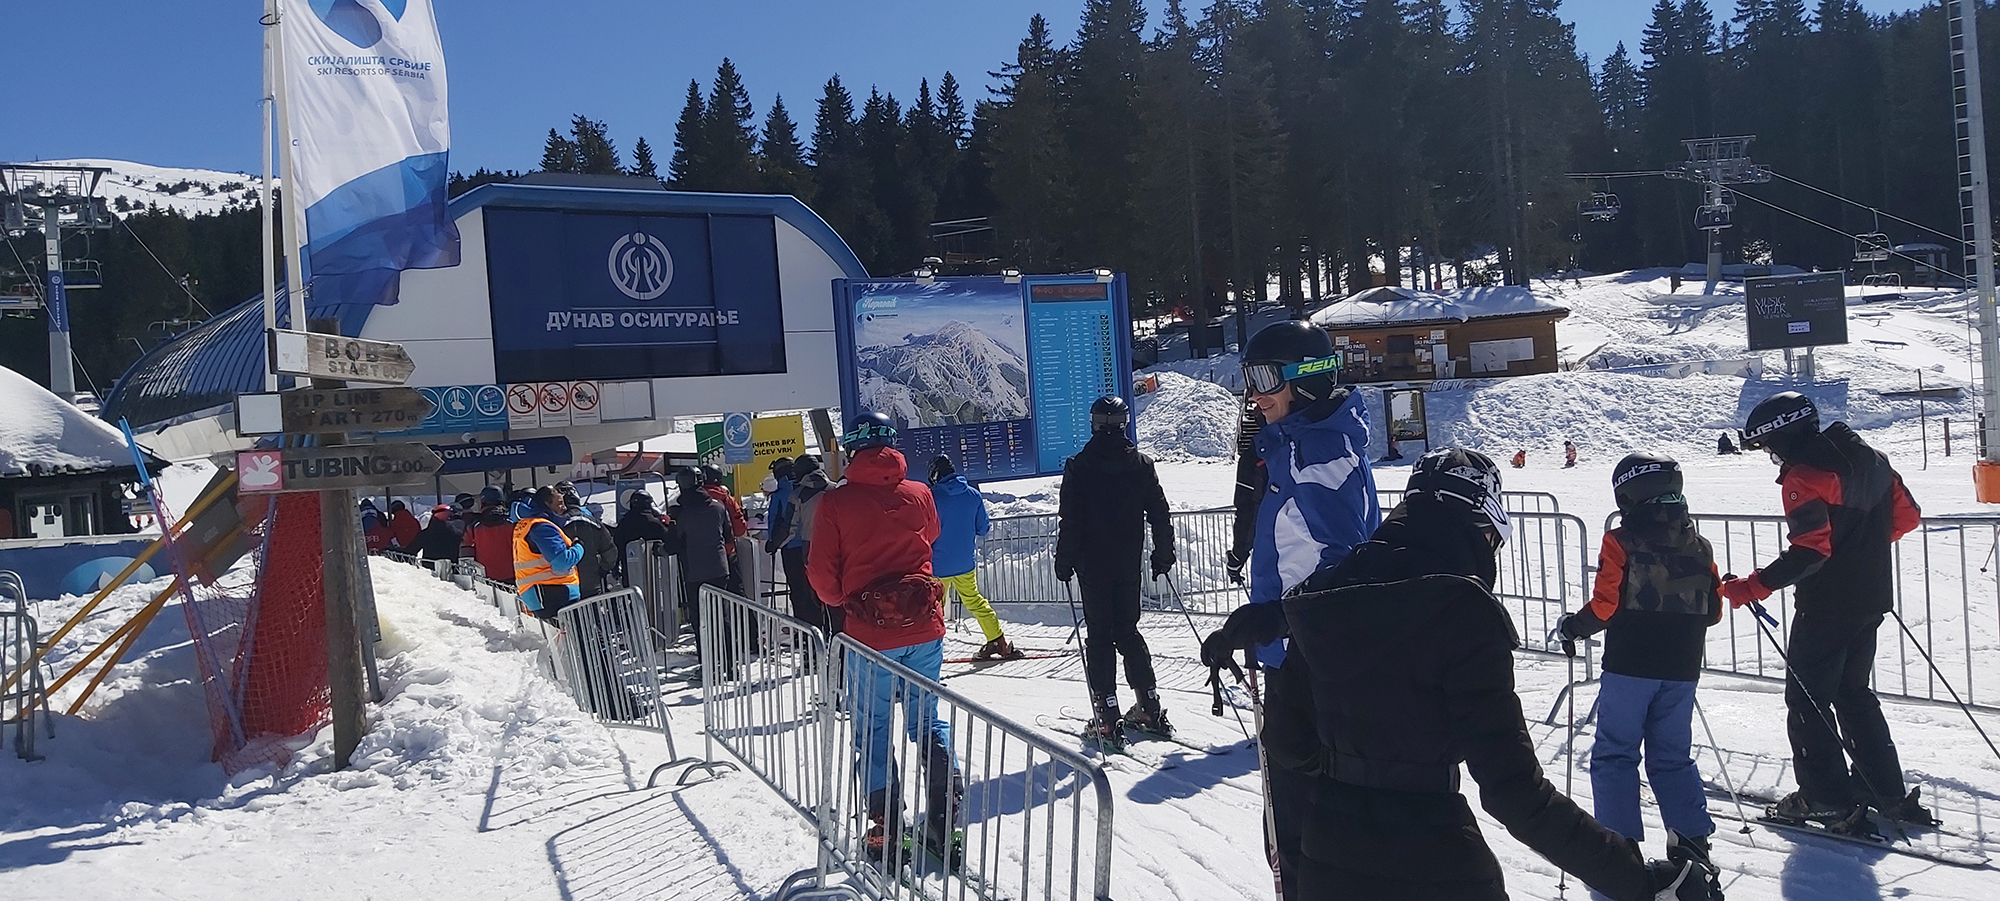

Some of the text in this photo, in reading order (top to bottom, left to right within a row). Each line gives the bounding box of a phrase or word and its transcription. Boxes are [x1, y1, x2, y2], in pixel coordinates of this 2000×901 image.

[308, 56, 431, 71] СКИЈАЛИШТА СРБИЈЕ
[317, 67, 425, 80] SKI RESORTS OF SERBIA
[546, 310, 740, 331] ДУНАВ ОСИГУРАЊЕ
[326, 338, 379, 362] BOB
[328, 360, 379, 377] START
[285, 391, 381, 409] ZIP LINE
[282, 456, 391, 479] TUBING
